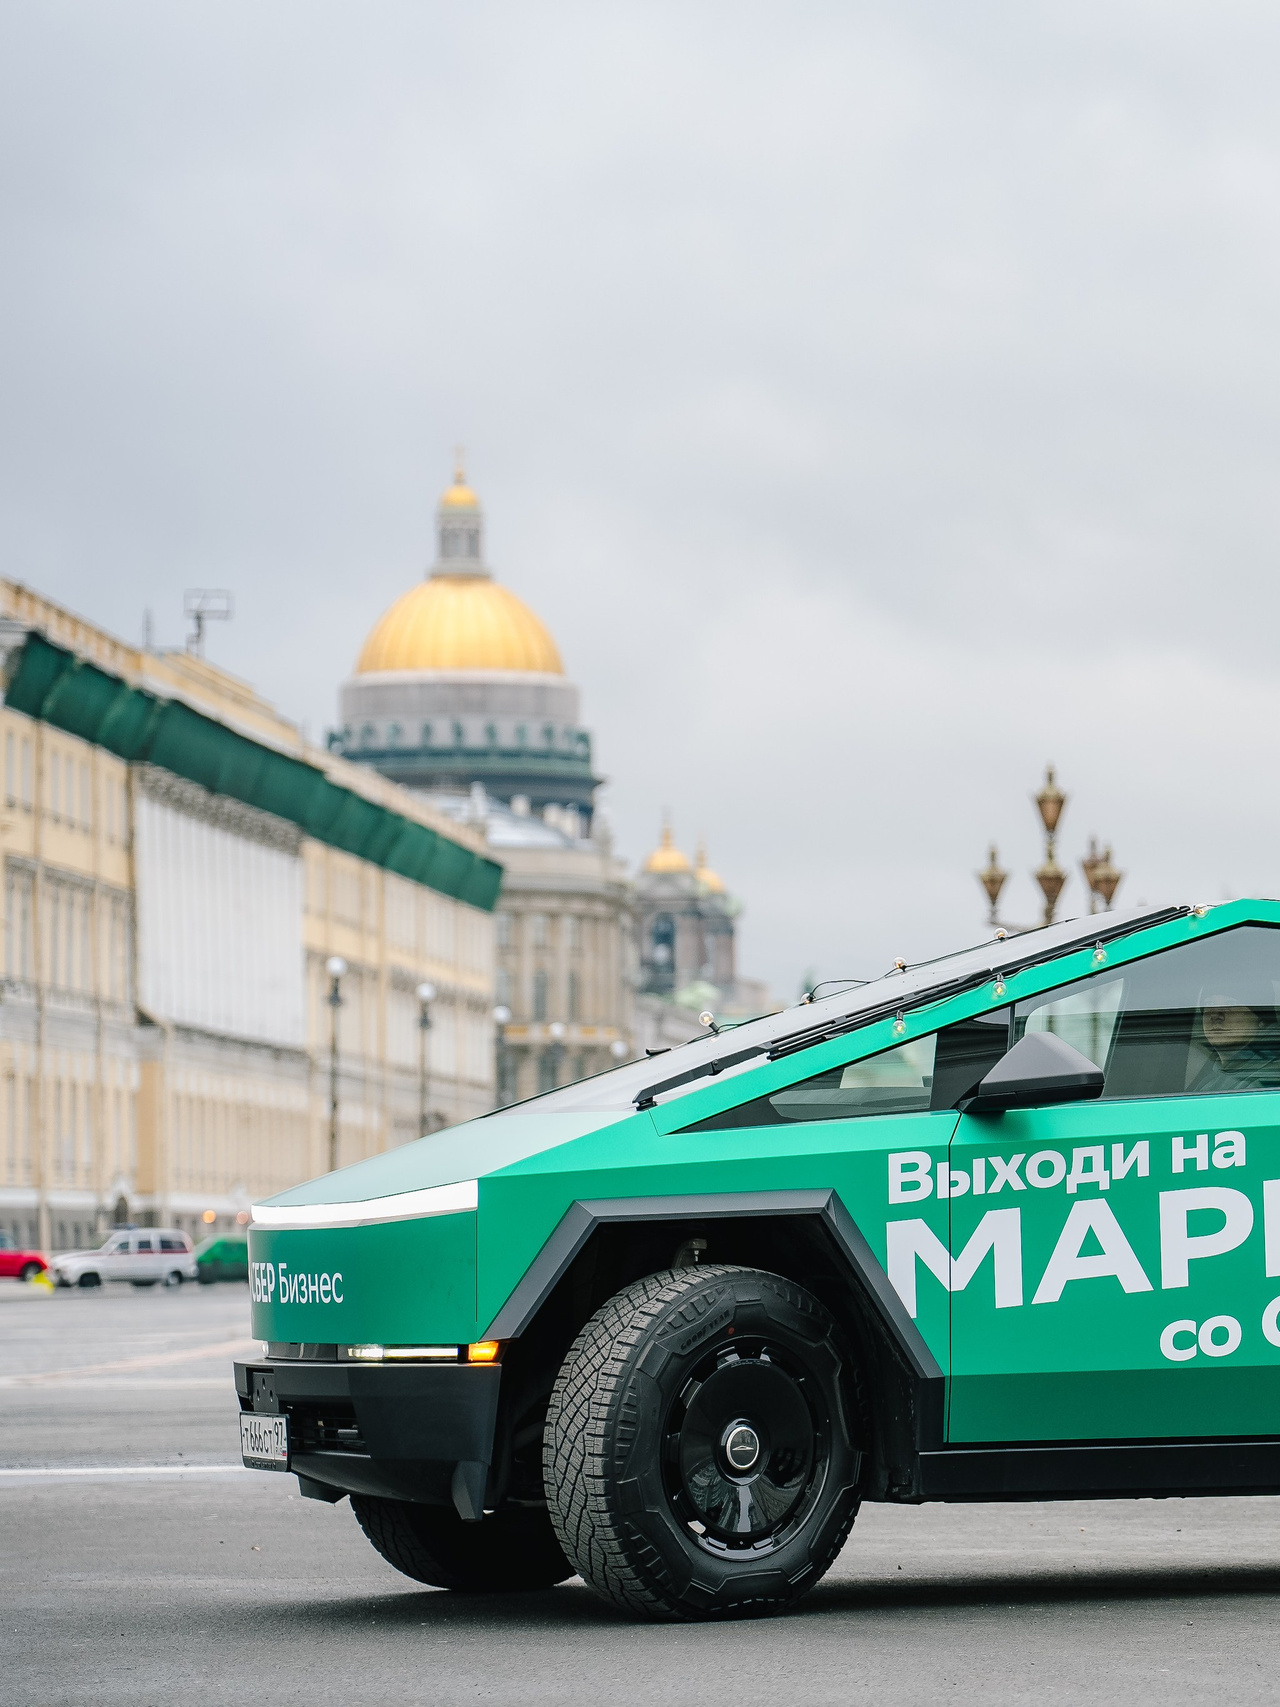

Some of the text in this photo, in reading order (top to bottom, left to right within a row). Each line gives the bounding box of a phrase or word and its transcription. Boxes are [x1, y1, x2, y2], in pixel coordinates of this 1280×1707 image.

[887, 1130, 1246, 1206] Выходи на
[278, 1262, 344, 1304] Бизнес
[1159, 1315, 1242, 1362] со
